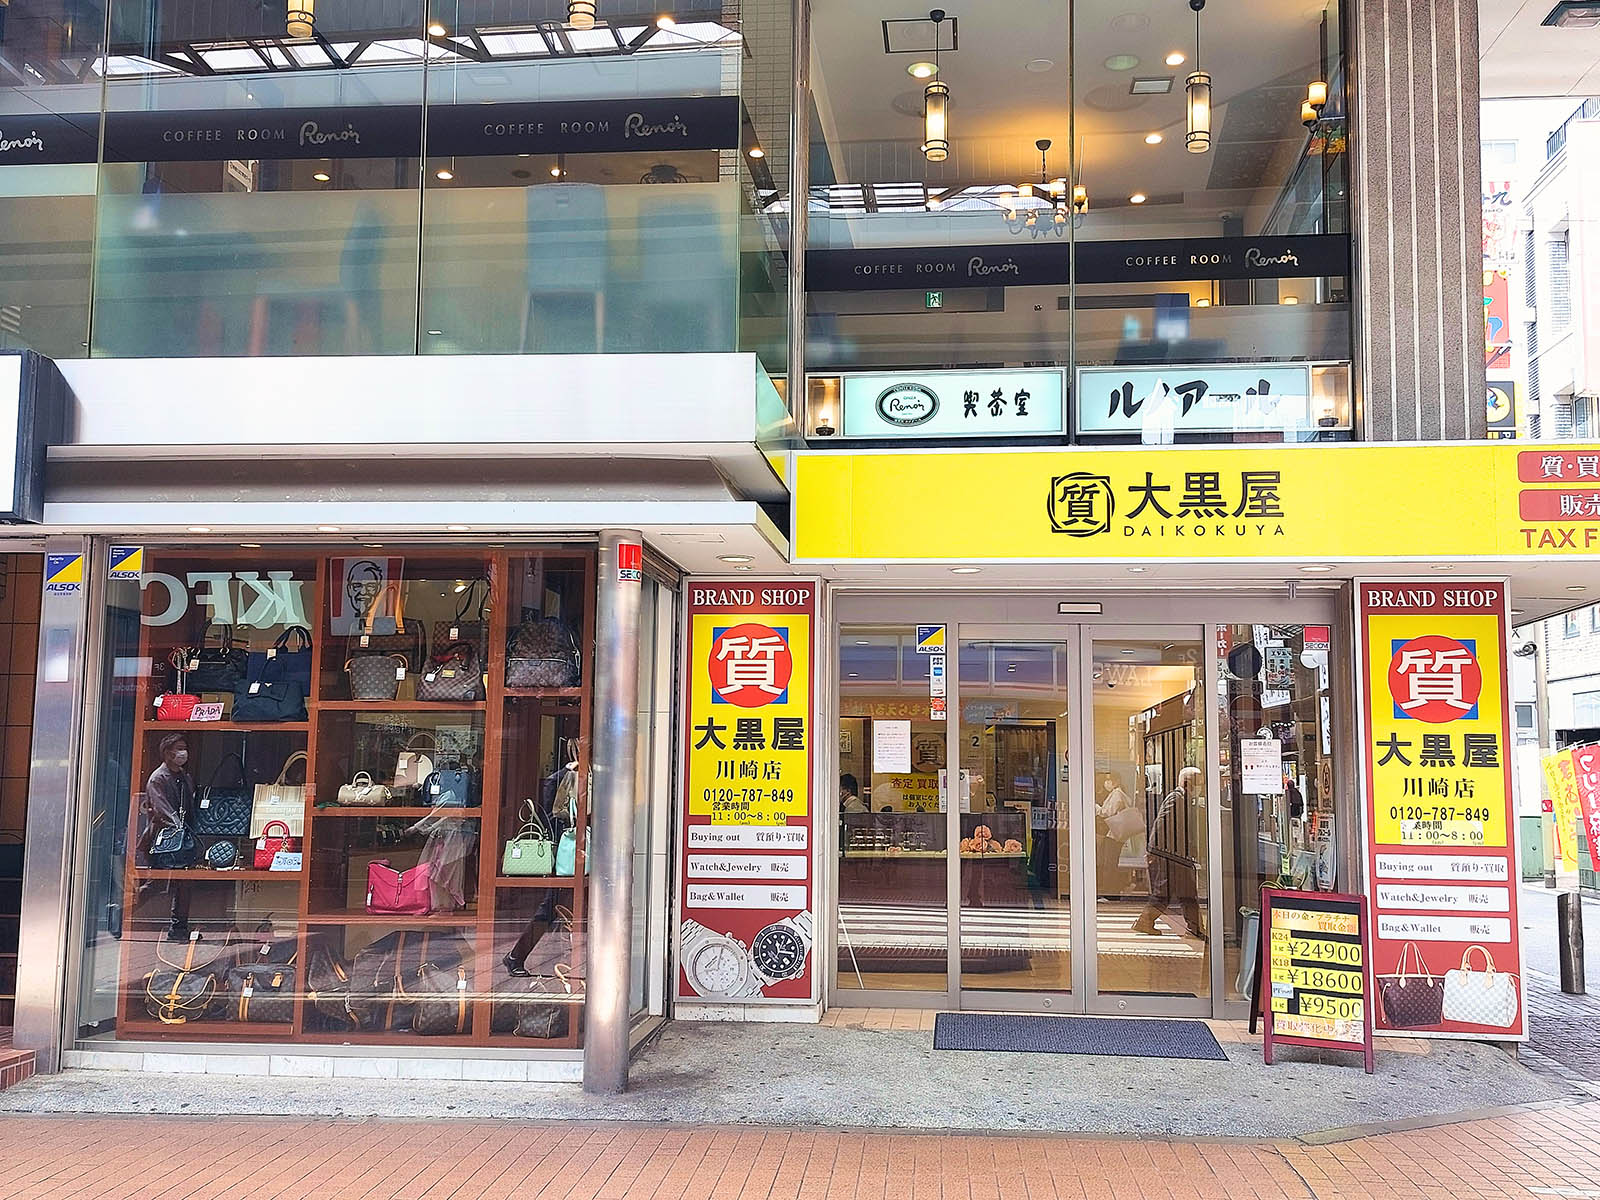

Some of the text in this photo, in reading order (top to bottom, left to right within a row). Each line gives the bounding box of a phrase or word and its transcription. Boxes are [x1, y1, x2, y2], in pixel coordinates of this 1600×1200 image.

[163, 120, 361, 146] COFFEE ROOM Renoir
[484, 112, 688, 138] COFFEE ROOM Renoir
[0, 130, 44, 151] enoir
[854, 256, 1019, 277] COFFEE ROOM Renoir
[1126, 247, 1299, 269] COFFEE ROOM Renoir
[963, 387, 1031, 418] 喫茶室
[1058, 482, 1101, 526] 質
[1124, 471, 1285, 519] 大黒屋
[1560, 493, 1600, 517] 販売
[1123, 524, 1286, 537] DAIKOKUYA
[1520, 528, 1598, 548] TAX F
[109, 571, 140, 579] ALSOK
[46, 583, 81, 592] ALSOK
[692, 589, 810, 606] BRAND SHOP
[1367, 590, 1498, 608] BRAND SHOP
[715, 635, 785, 696] 質
[1396, 648, 1473, 711] 質
[194, 705, 221, 717] PRADA
[694, 717, 805, 751] 大黒屋
[971, 736, 980, 747] 2
[916, 738, 942, 766] 質
[1376, 732, 1500, 768] 大黒屋
[715, 759, 782, 781] 川崎店
[891, 777, 939, 789] 査定 買取
[1402, 777, 1475, 799] 川崎店
[703, 788, 794, 803] 0120-787-849
[712, 802, 750, 812] 営業時間
[1390, 806, 1490, 821] 0120-787-849
[690, 832, 741, 843] Buying out
[690, 862, 762, 873] Watch&Jewelry
[1379, 861, 1433, 872] Buying out
[690, 891, 745, 902] Bag&Wallet
[1380, 892, 1459, 904] Watch&Jewelry
[1272, 932, 1288, 941] K24
[1381, 922, 1442, 933] Bag&Wallet
[1287, 941, 1360, 962] ¥24900
[1272, 958, 1289, 967] K18
[1287, 969, 1362, 992] ¥18600
[1300, 996, 1361, 1018] ¥9500
